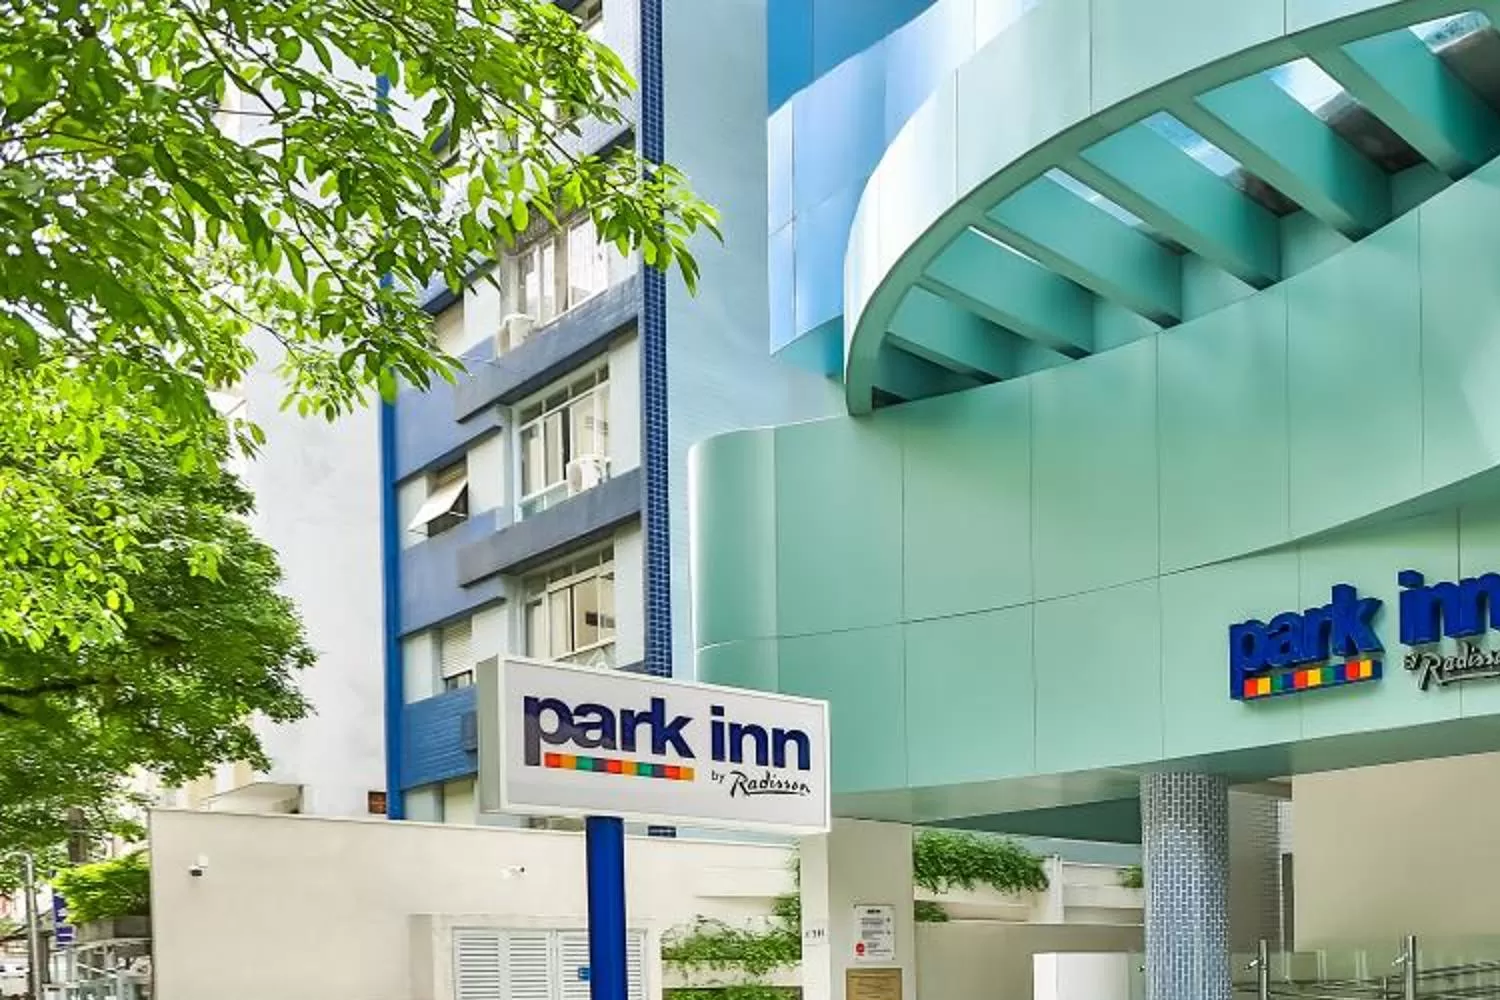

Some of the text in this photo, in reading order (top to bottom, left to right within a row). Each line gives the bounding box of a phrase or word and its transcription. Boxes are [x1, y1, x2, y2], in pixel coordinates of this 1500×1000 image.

[1229, 583, 1386, 700] park
[523, 695, 812, 771] park inn
[711, 769, 811, 799] by Radisson
